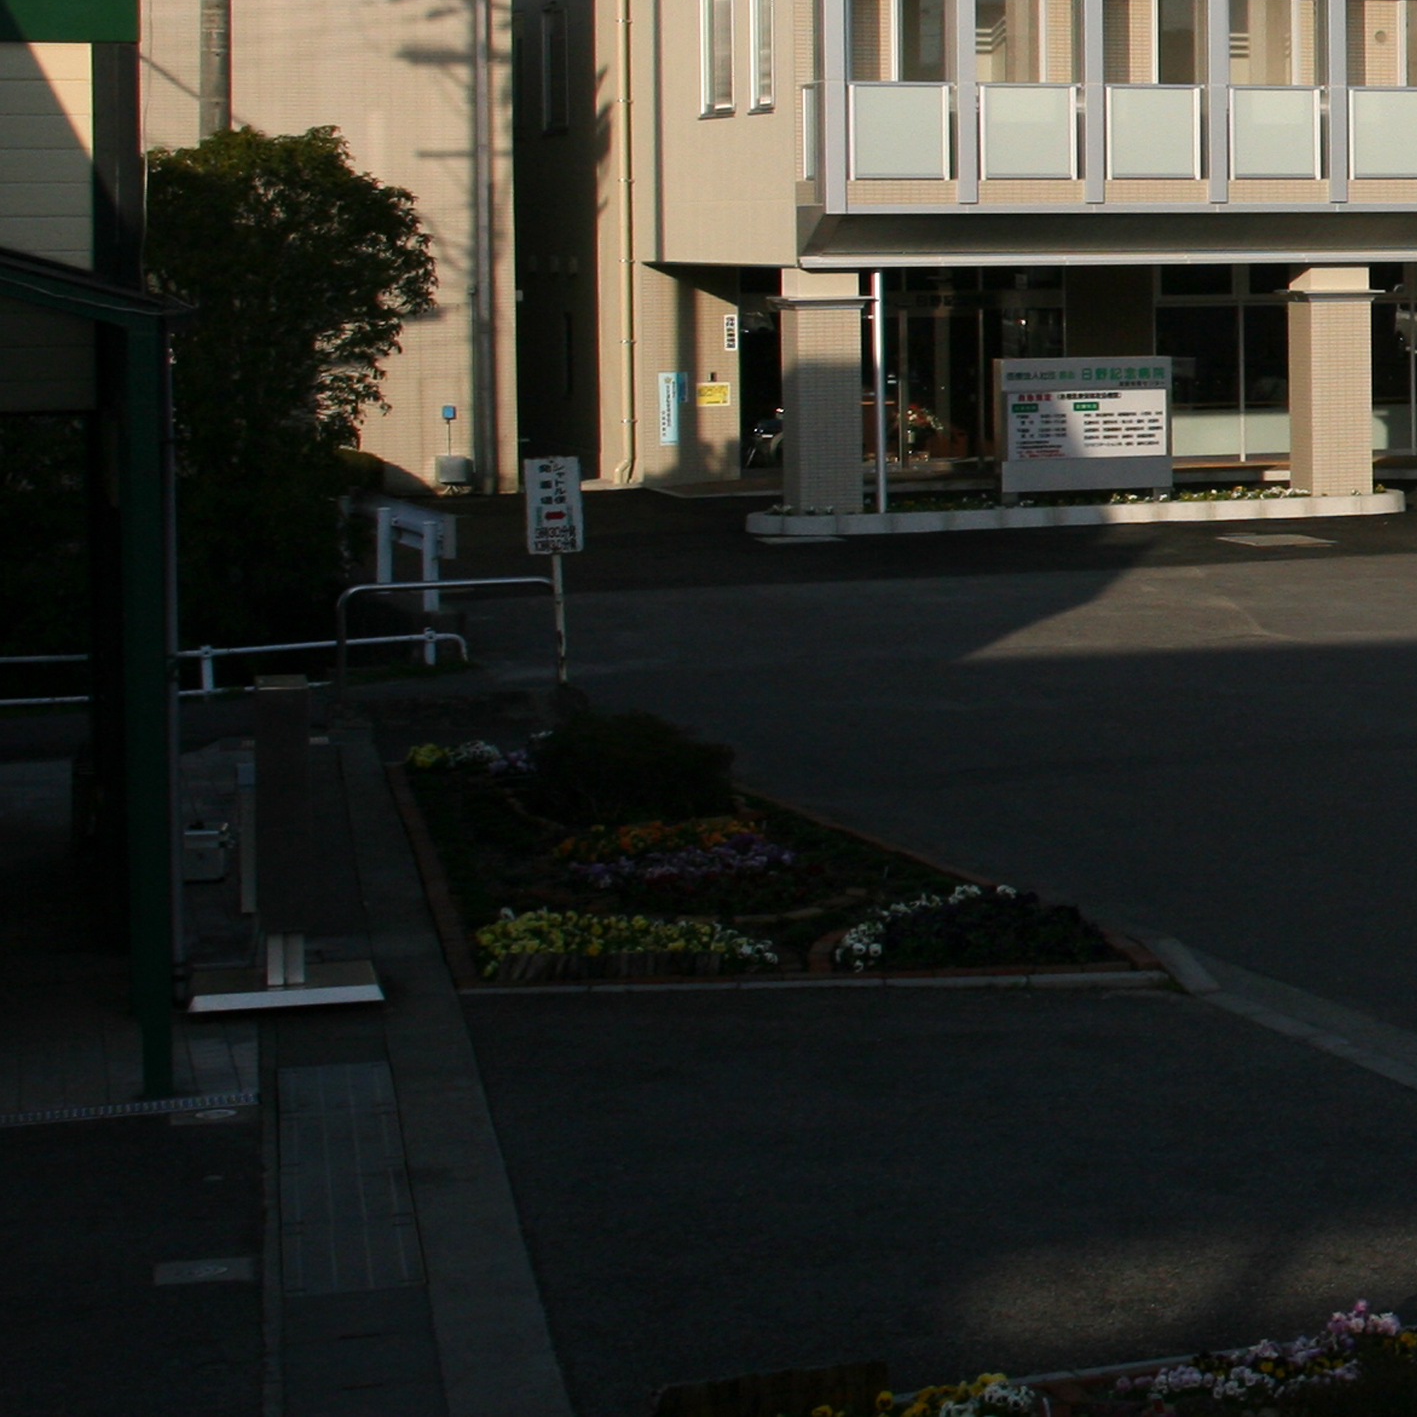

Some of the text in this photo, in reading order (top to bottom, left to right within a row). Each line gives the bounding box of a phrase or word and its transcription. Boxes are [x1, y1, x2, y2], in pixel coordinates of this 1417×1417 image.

[1081, 367, 1166, 381] 日野記念病院
